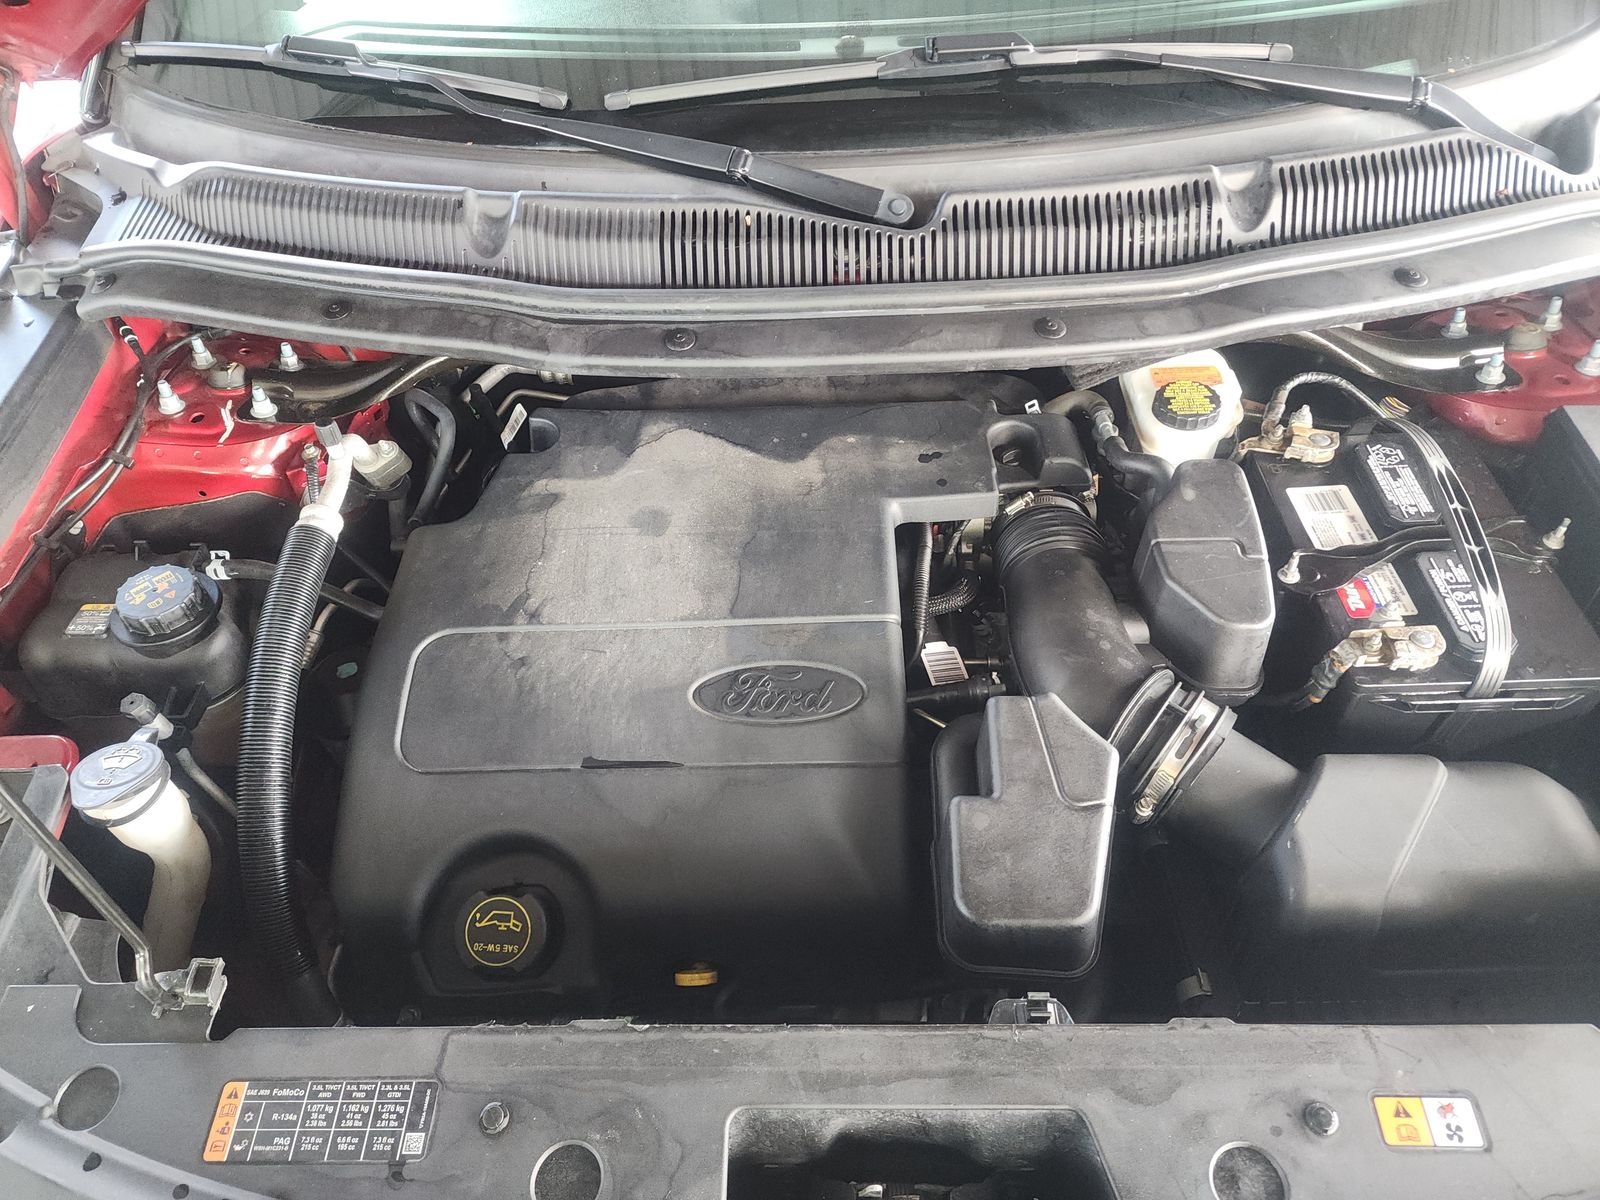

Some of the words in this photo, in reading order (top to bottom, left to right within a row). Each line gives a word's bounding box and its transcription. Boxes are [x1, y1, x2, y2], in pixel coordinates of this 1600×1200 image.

[723, 672, 835, 714] Ford
[473, 942, 501, 953] 5W-20
[502, 944, 519, 953] SAE
[272, 1088, 305, 1096] FoMoCo
[307, 1104, 325, 1112] 1.077
[325, 1104, 334, 1114] kg
[342, 1104, 360, 1112] 1.162
[360, 1104, 370, 1114] kg
[378, 1104, 395, 1112] 1.276
[395, 1104, 405, 1114] kg
[271, 1113, 298, 1121] R-134a
[273, 1137, 291, 1145] PAG
